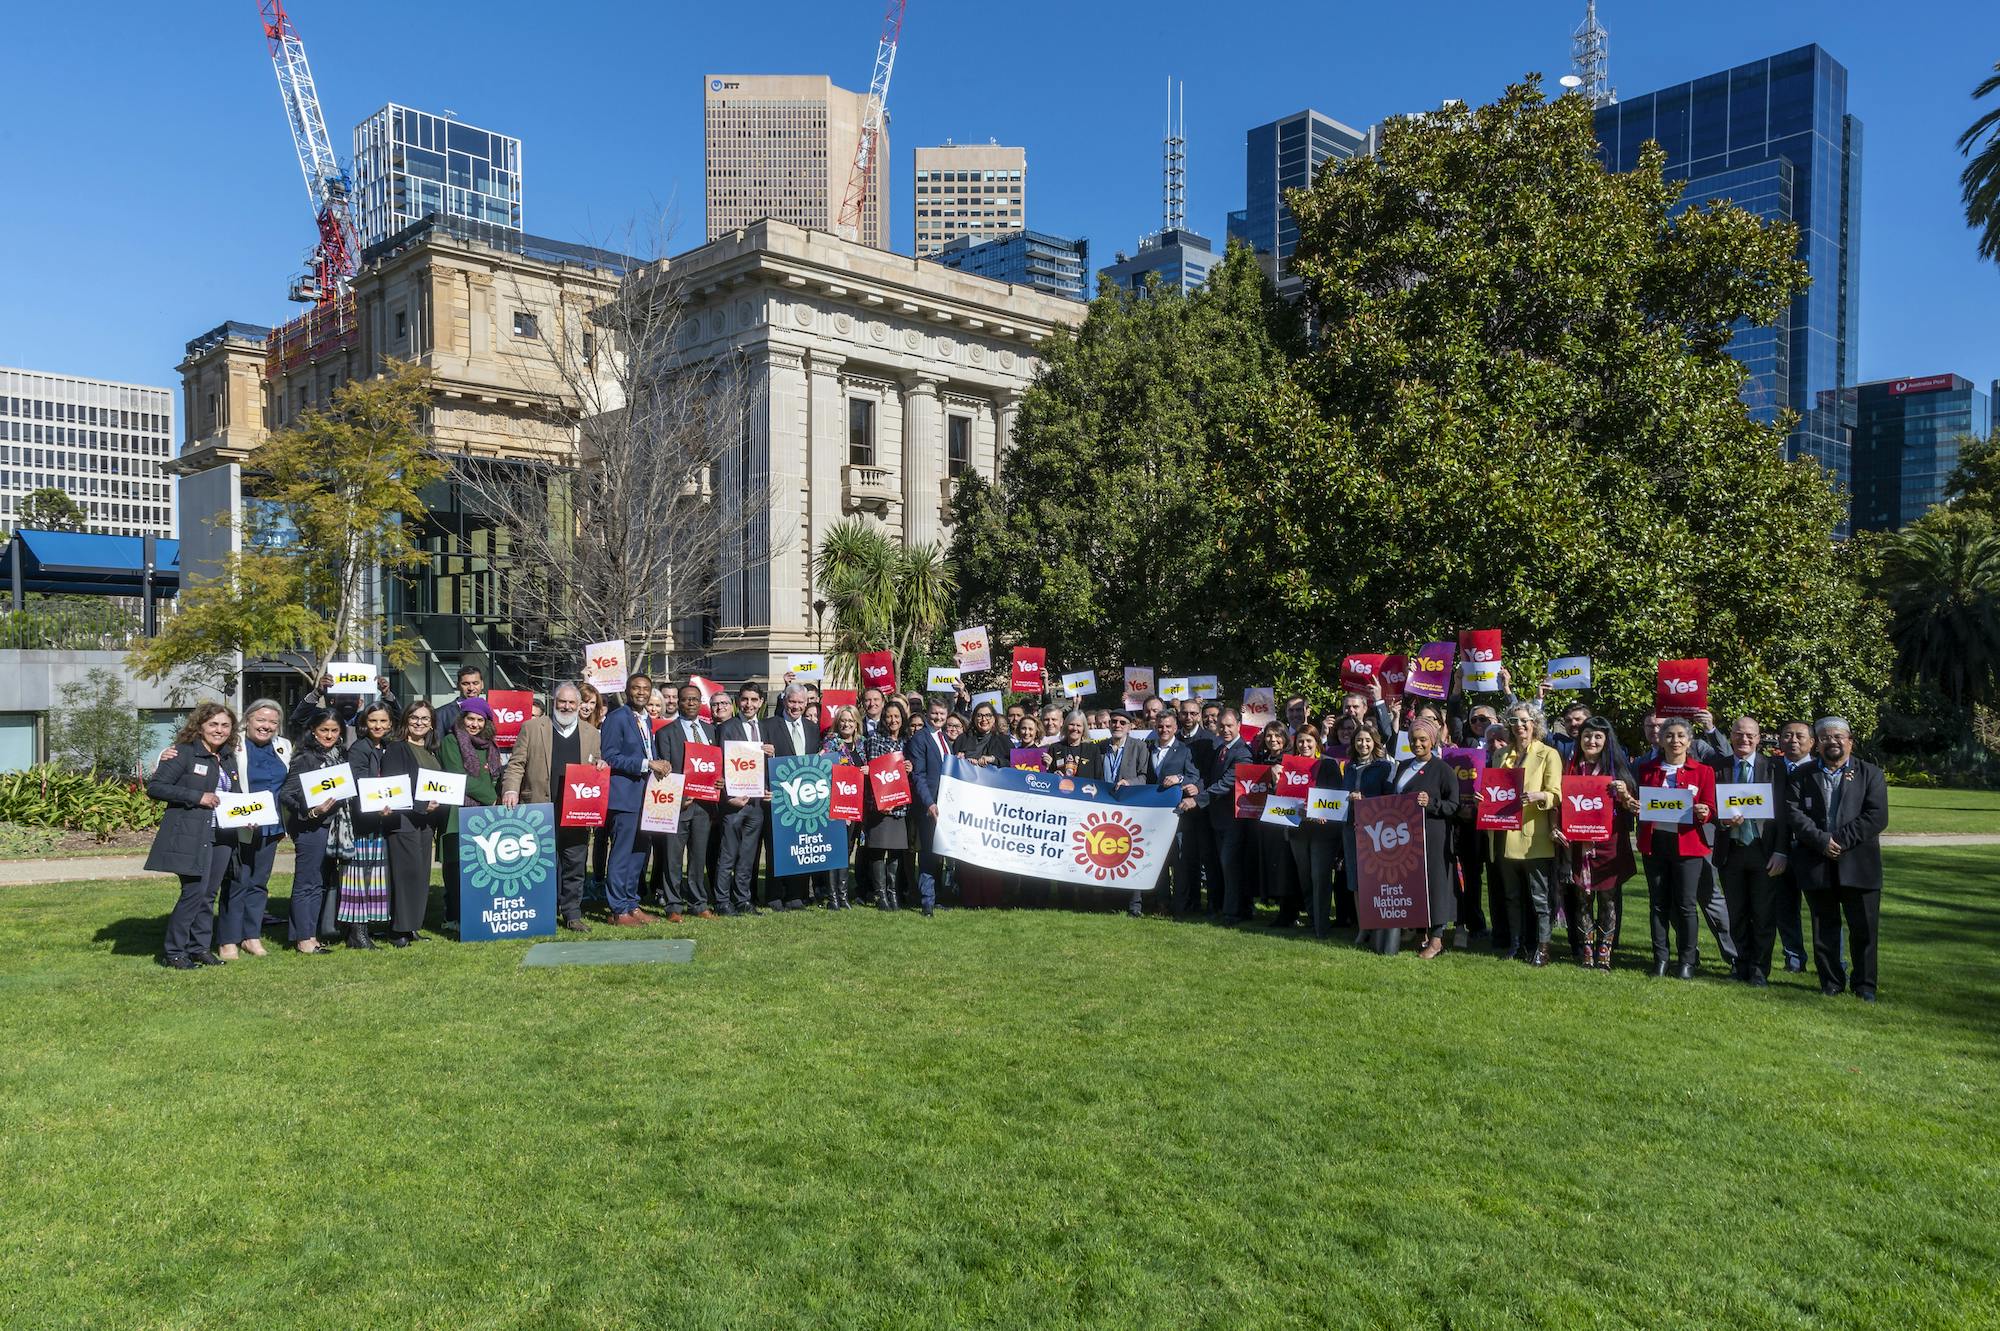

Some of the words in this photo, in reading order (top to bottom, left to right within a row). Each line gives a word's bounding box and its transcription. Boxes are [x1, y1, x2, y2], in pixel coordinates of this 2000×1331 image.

[962, 640, 982, 652] Yes
[1465, 648, 1493, 661] Yes
[592, 656, 618, 669] Yes
[1016, 660, 1038, 672] Yes
[1348, 659, 1372, 674] Yes
[1418, 657, 1444, 672] Yes
[339, 673, 366, 682] Haa
[864, 666, 888, 678] Yes
[1382, 670, 1406, 684] Yes
[1128, 680, 1148, 691] Yes
[1664, 678, 1698, 694] Yes
[493, 708, 524, 723] Yes
[1247, 703, 1268, 714] Yes
[690, 758, 716, 772] Yes
[730, 758, 756, 772] Yes
[874, 770, 901, 784] Yes
[1285, 771, 1309, 785] Yes
[570, 782, 601, 799] Yes
[780, 777, 830, 807] Yes
[836, 781, 857, 795] Yes
[1240, 780, 1267, 794] Yes
[1486, 786, 1516, 802] Yes
[651, 790, 674, 804] Yes
[1568, 794, 1604, 812] Yes
[1729, 796, 1762, 806] Evet
[1650, 799, 1682, 810] Evet
[992, 802, 1067, 827] Victorian
[958, 810, 1066, 843] Multicultural
[798, 832, 823, 844] First
[1085, 831, 1129, 856] Yes
[1364, 821, 1411, 852] Yes
[472, 831, 537, 865] Yes
[790, 843, 832, 857] Nations
[981, 832, 1035, 855] Voices
[1040, 844, 1064, 859] for
[797, 853, 826, 865] Voice
[1380, 884, 1403, 896] First
[494, 896, 525, 910] First
[1373, 896, 1413, 909] Nations
[482, 908, 536, 923] Nations
[1380, 907, 1407, 919] Voice
[490, 920, 528, 934] Voice
